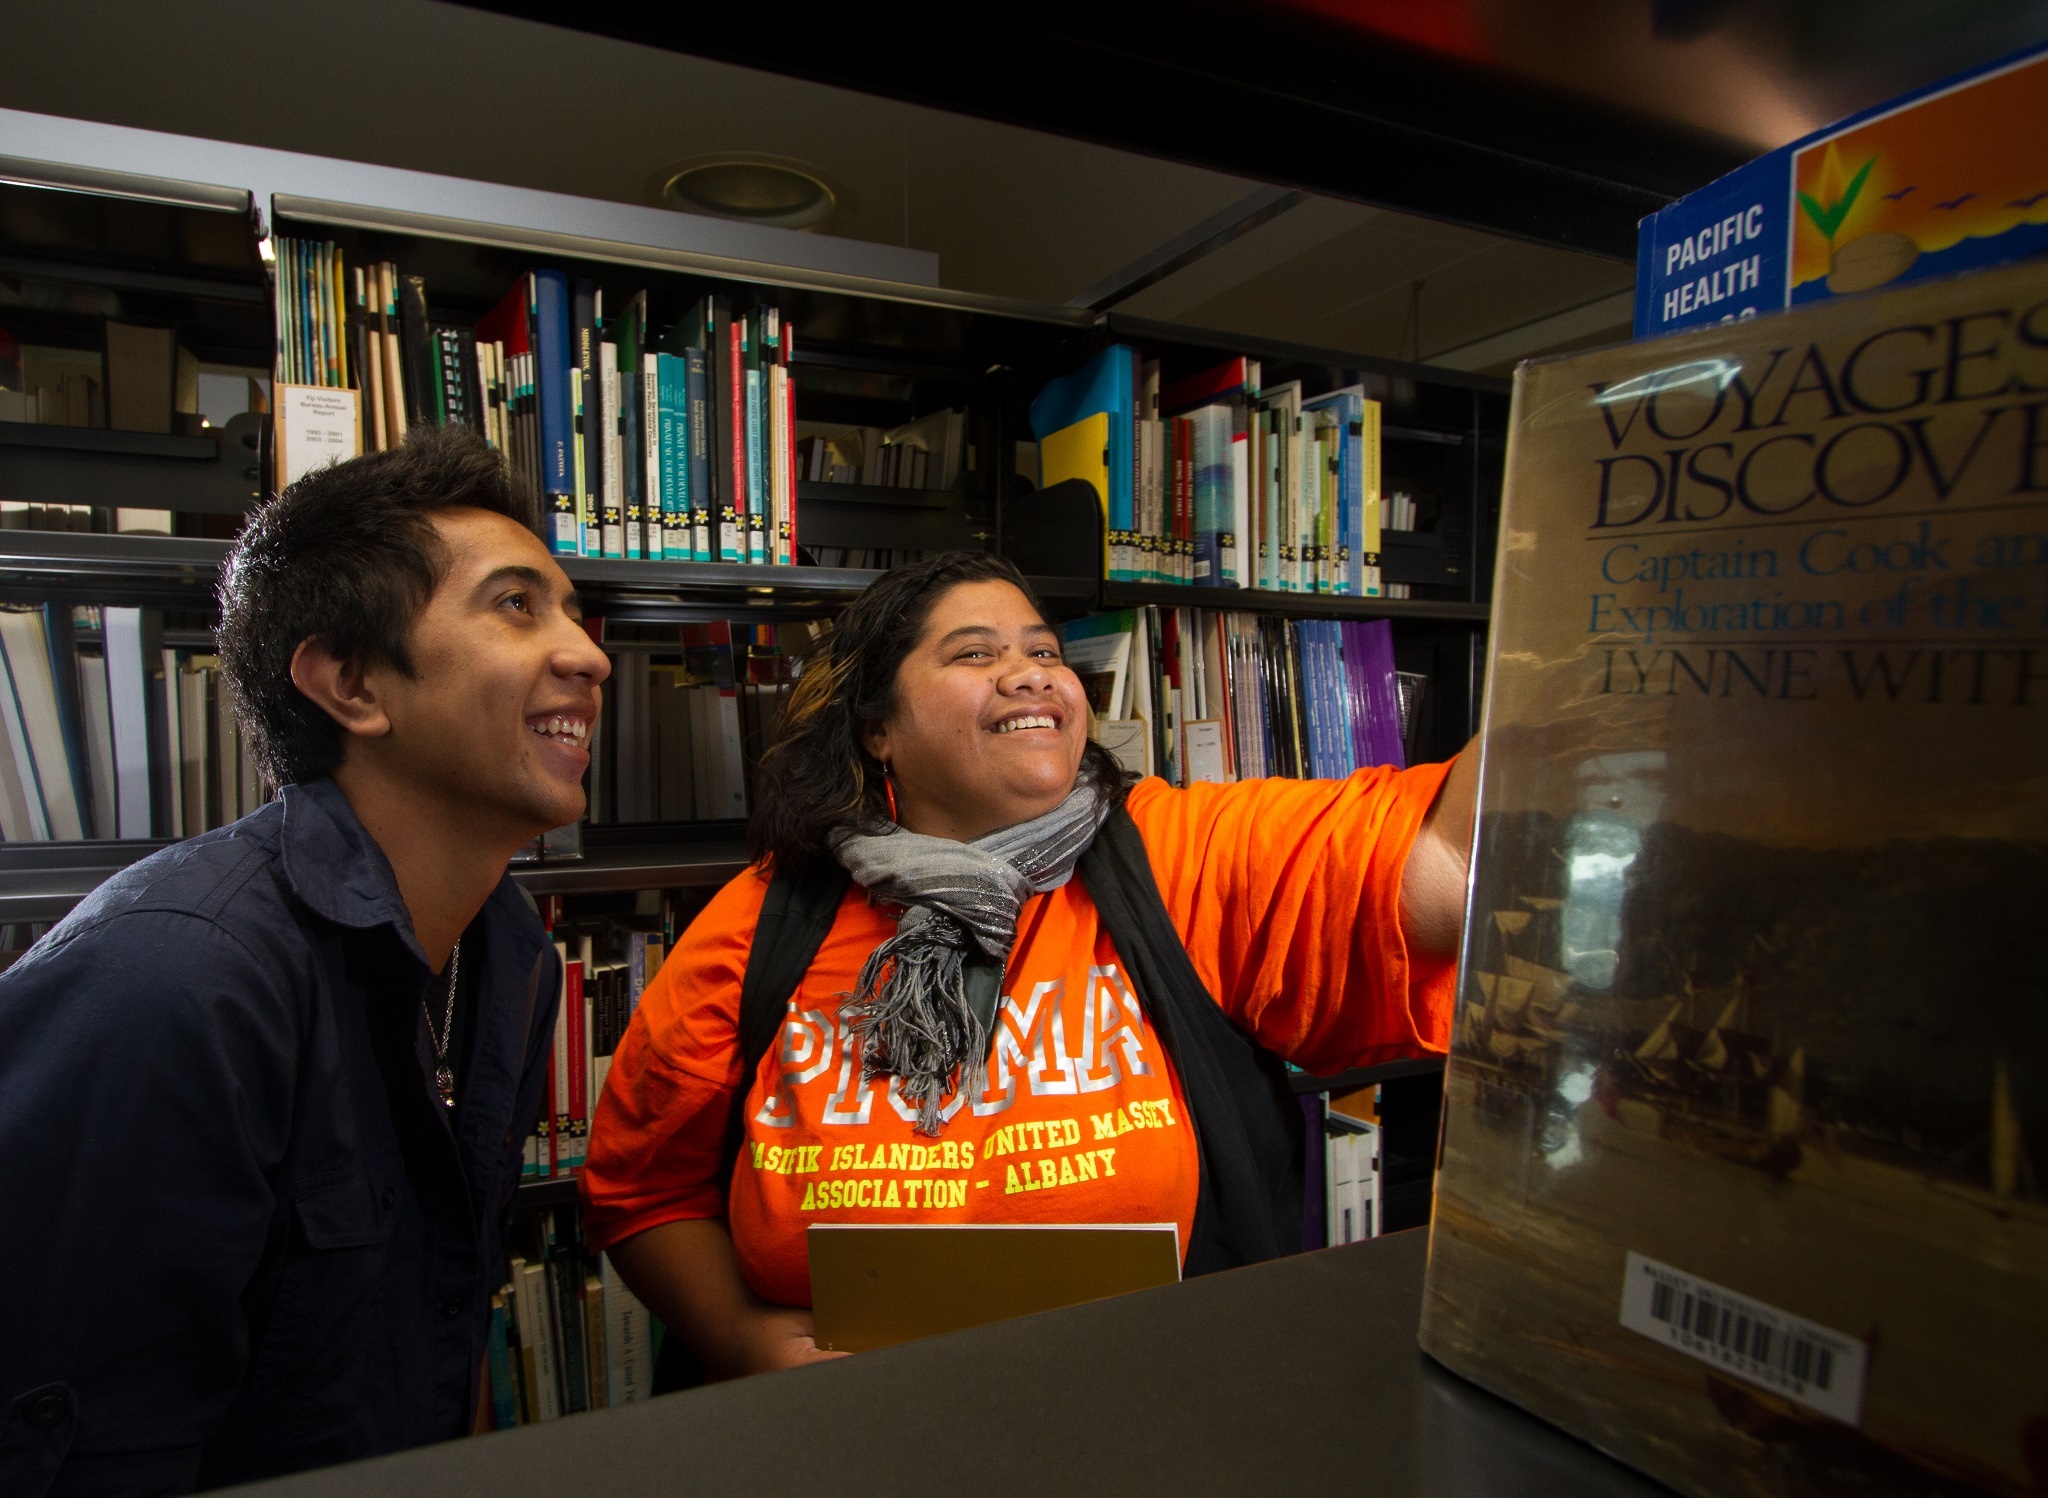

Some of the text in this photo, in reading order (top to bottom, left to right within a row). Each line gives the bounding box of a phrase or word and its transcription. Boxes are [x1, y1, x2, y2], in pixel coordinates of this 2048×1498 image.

[1665, 204, 1764, 277] PACIFIC
[1662, 255, 1759, 322] HEALTH
[313, 409, 335, 417] Report
[1602, 540, 1778, 593] Captain
[1799, 520, 1949, 577] Cook
[1586, 588, 1848, 644] Exploration
[1859, 576, 1926, 632] of
[1930, 576, 2026, 629] the
[1598, 649, 1818, 700] LYNNE
[830, 1140, 976, 1172] ISLANDERS
[983, 1119, 1081, 1161] UNITED
[1090, 1098, 1176, 1141] MASSEY
[800, 1178, 969, 1211] ASSOCIATION
[1004, 1147, 1118, 1195] ALBANY
[622, 1310, 633, 1345] Towards
[625, 1359, 636, 1387] United
